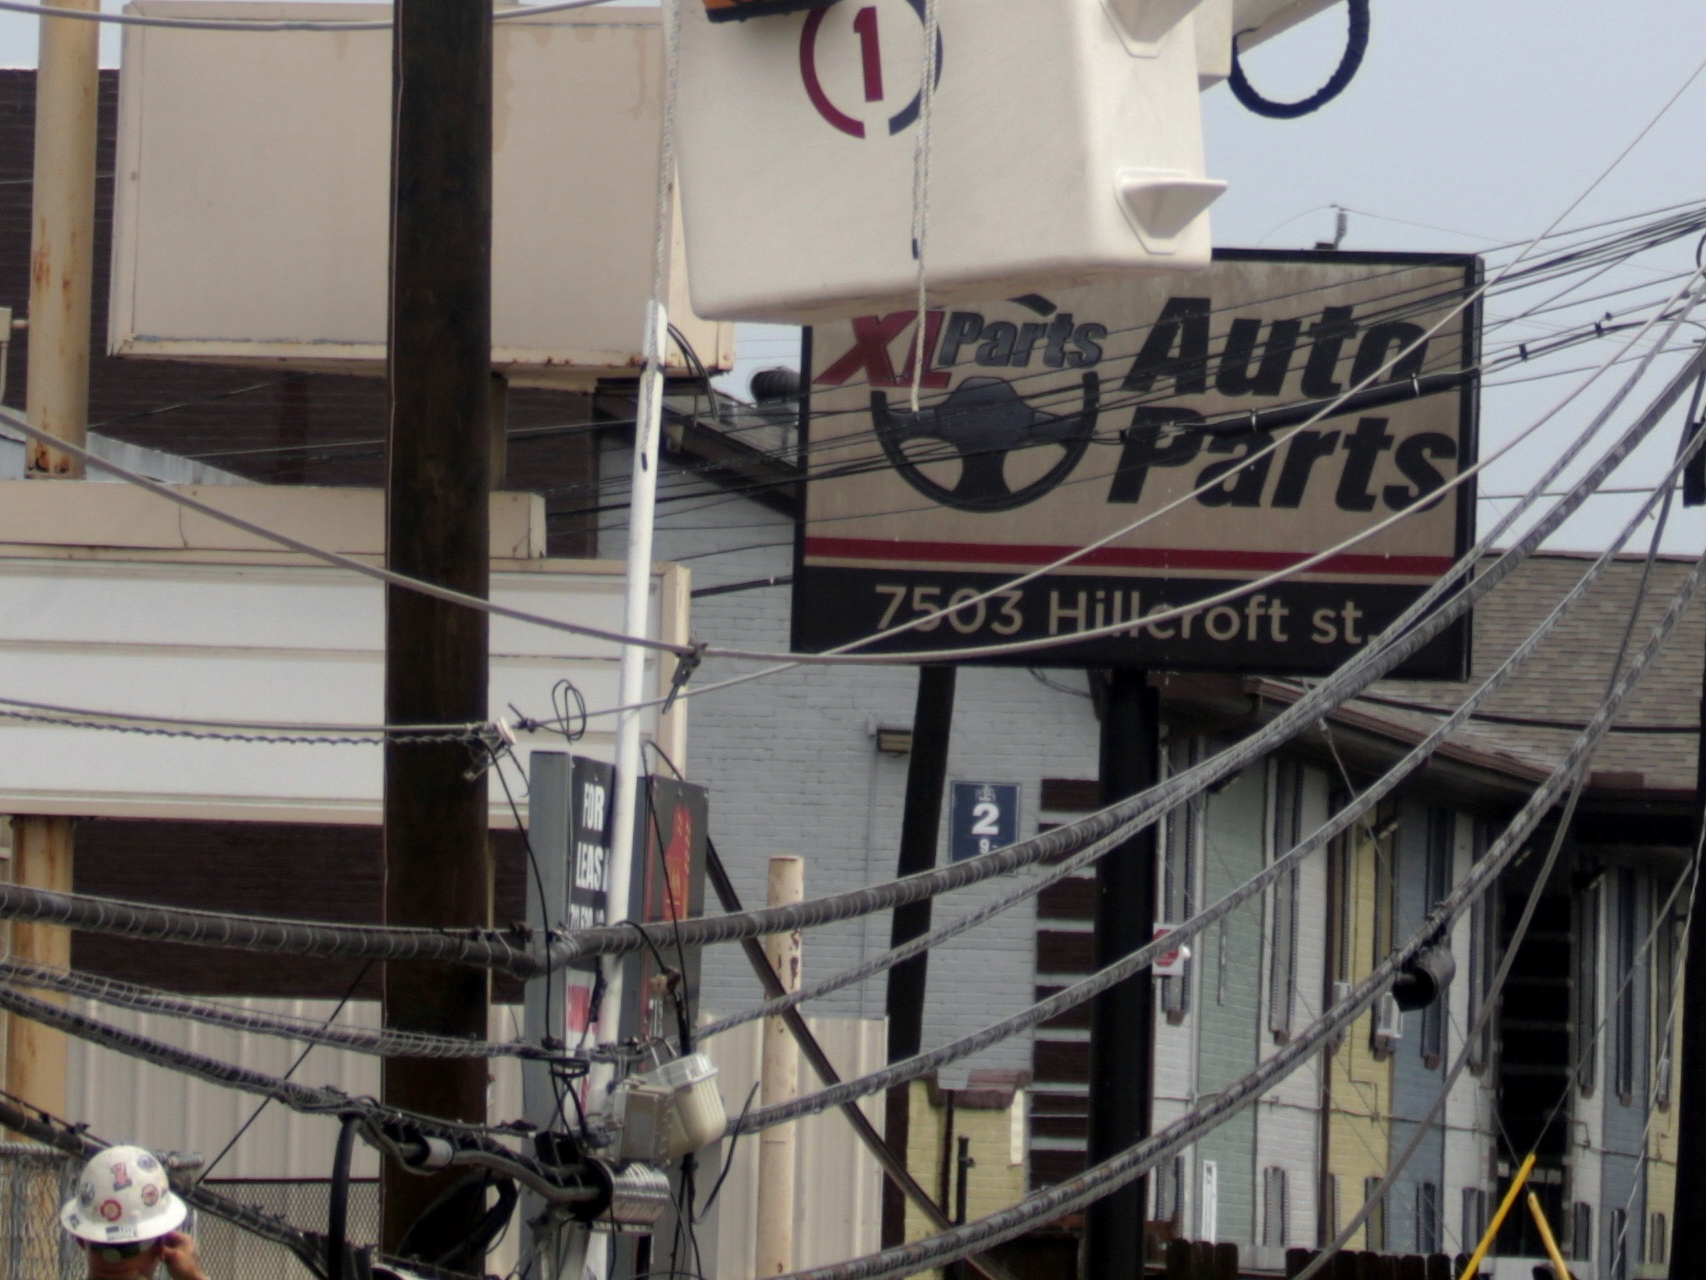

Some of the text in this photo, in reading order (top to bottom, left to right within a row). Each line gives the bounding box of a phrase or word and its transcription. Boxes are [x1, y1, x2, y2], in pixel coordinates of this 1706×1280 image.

[1120, 297, 1430, 399] Auto
[1106, 406, 1458, 513] Parts
[875, 584, 1024, 635] 7503
[1049, 590, 1290, 642] Hillcroft
[582, 781, 605, 832] FOR
[971, 802, 1000, 835] 2
